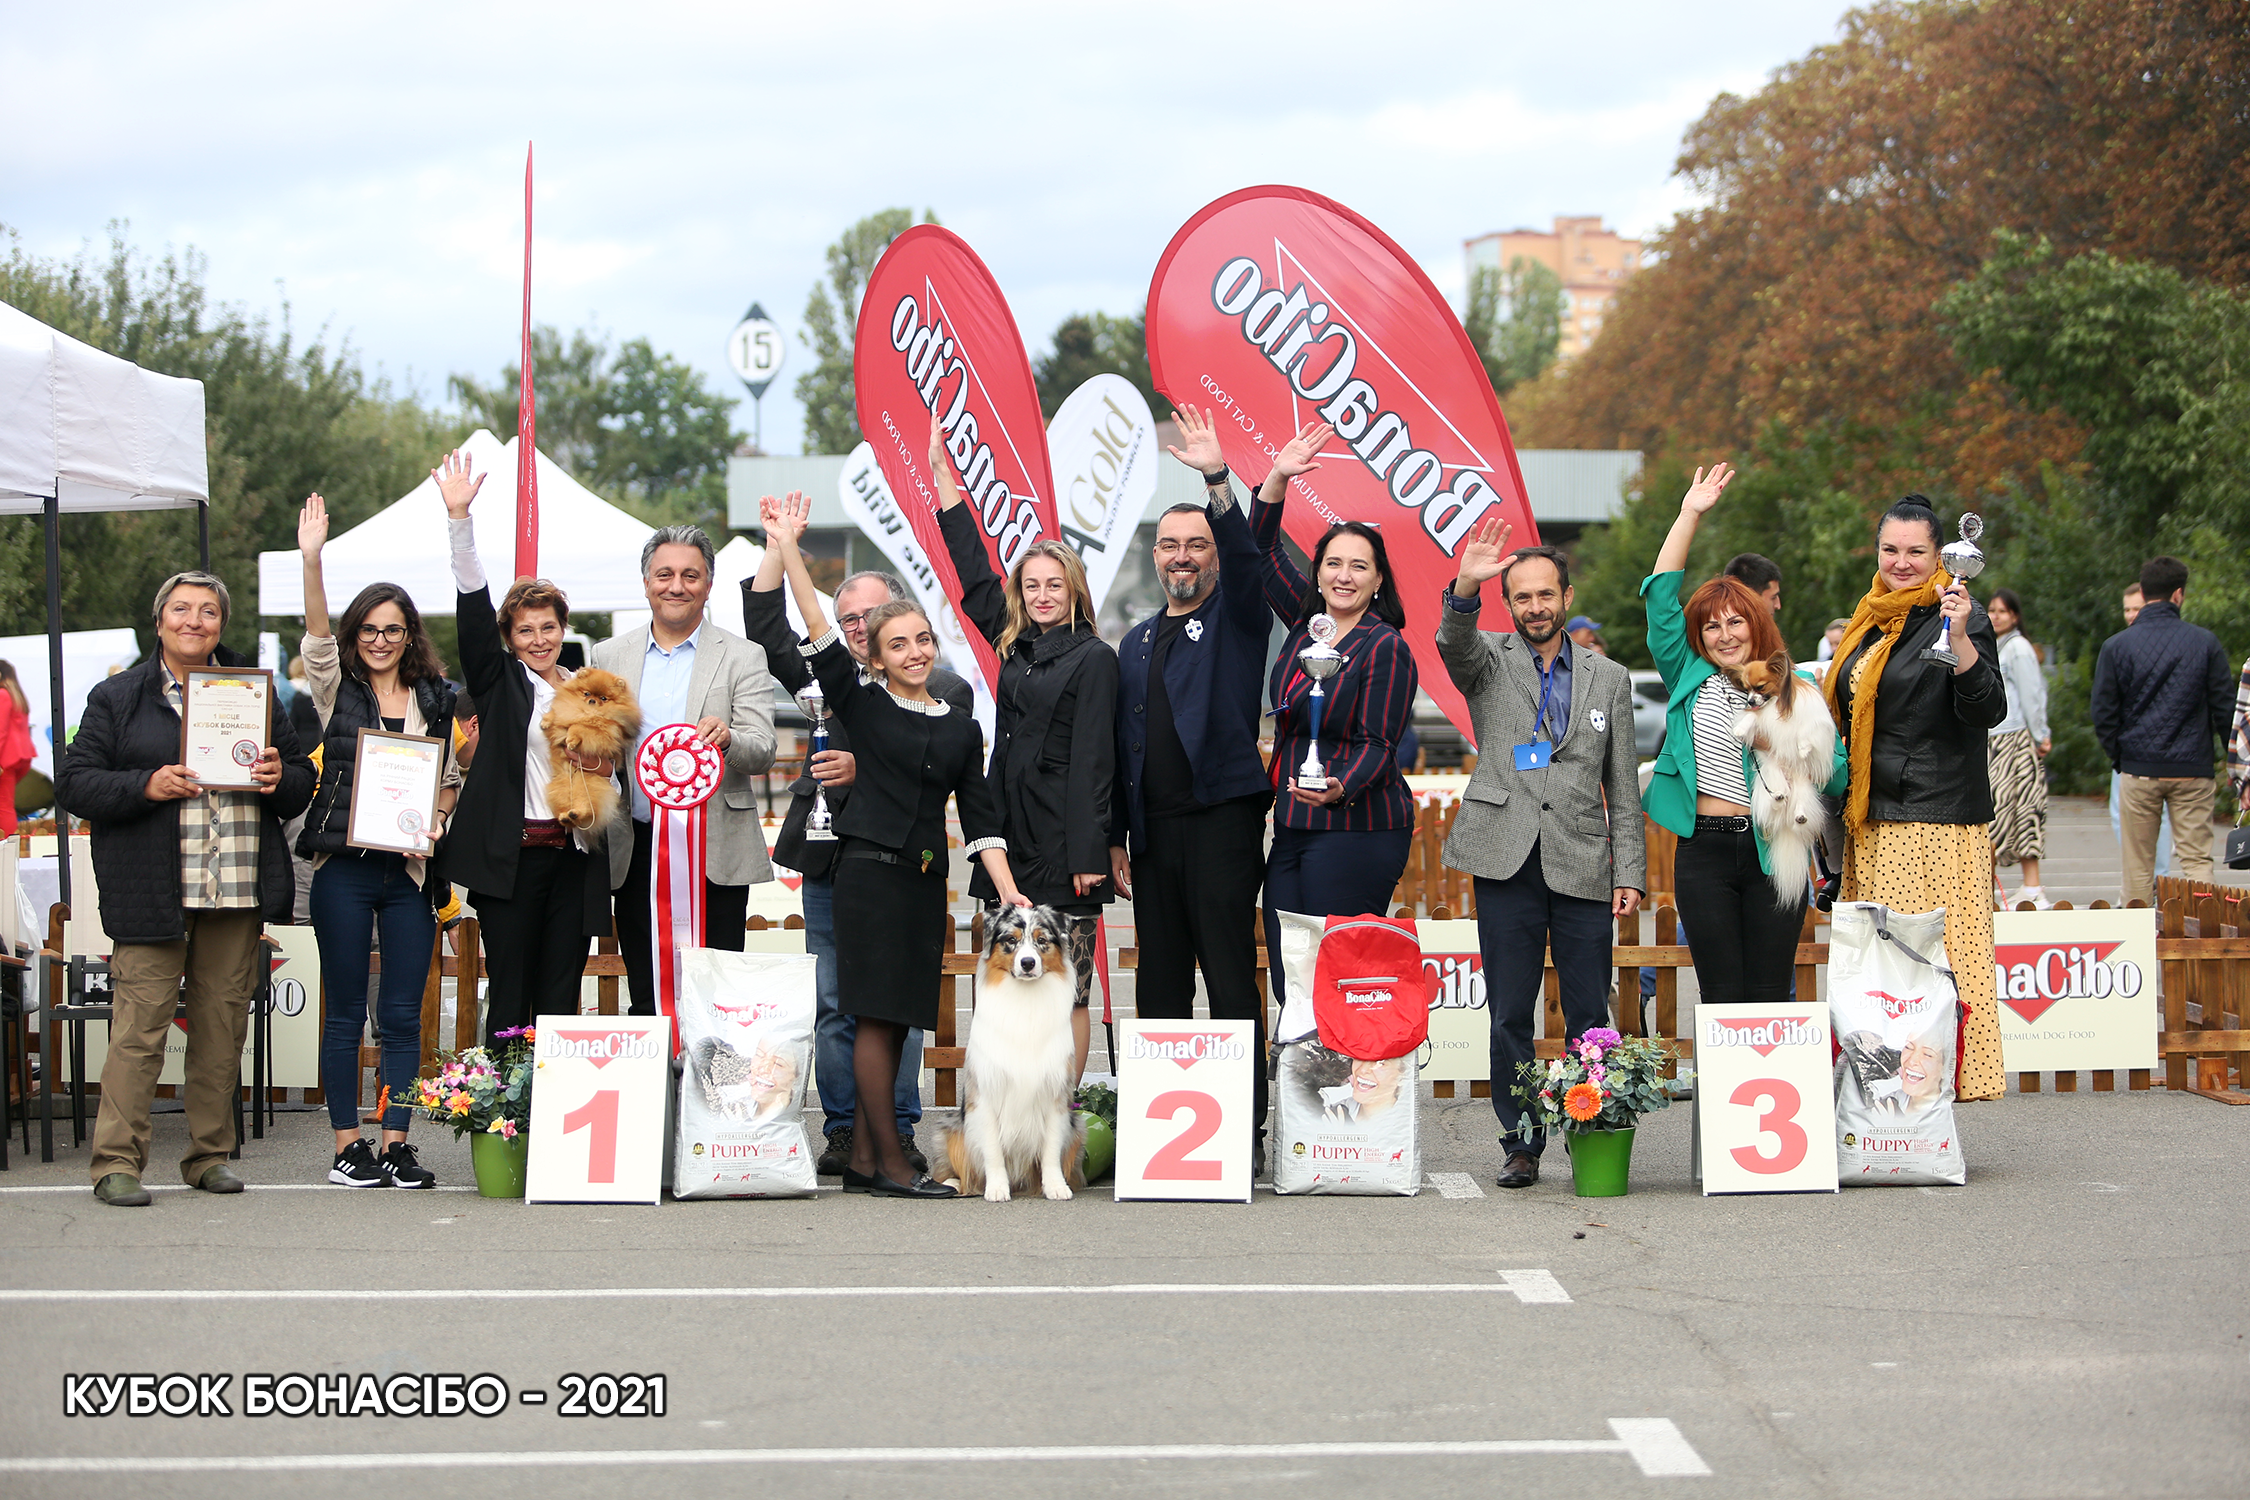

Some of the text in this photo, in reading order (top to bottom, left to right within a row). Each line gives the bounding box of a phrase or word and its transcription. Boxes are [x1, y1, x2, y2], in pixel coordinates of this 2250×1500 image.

[742, 330, 772, 369] 15
[1069, 391, 1134, 533] Gold
[372, 760, 425, 774] СЕРТИФІКАТ
[1995, 946, 2143, 1000] naCibo
[1345, 990, 1392, 1004] BonaCibo
[1854, 993, 1932, 1015] BonaCibo
[543, 1031, 660, 1060] BonaCibo
[1442, 1040, 1470, 1049] FOOD
[1704, 1018, 1822, 1047] BonaCibo
[2001, 1030, 2096, 1040] REMIUM DOG FOOD
[1127, 1033, 1244, 1062] BonaCibo
[563, 1090, 620, 1184] 1
[1142, 1090, 1222, 1180] 2
[1728, 1078, 1808, 1174] 3
[711, 1144, 761, 1158] PUPPY
[1312, 1144, 1363, 1160] PUPPY
[1862, 1137, 1912, 1152] PUPPY
